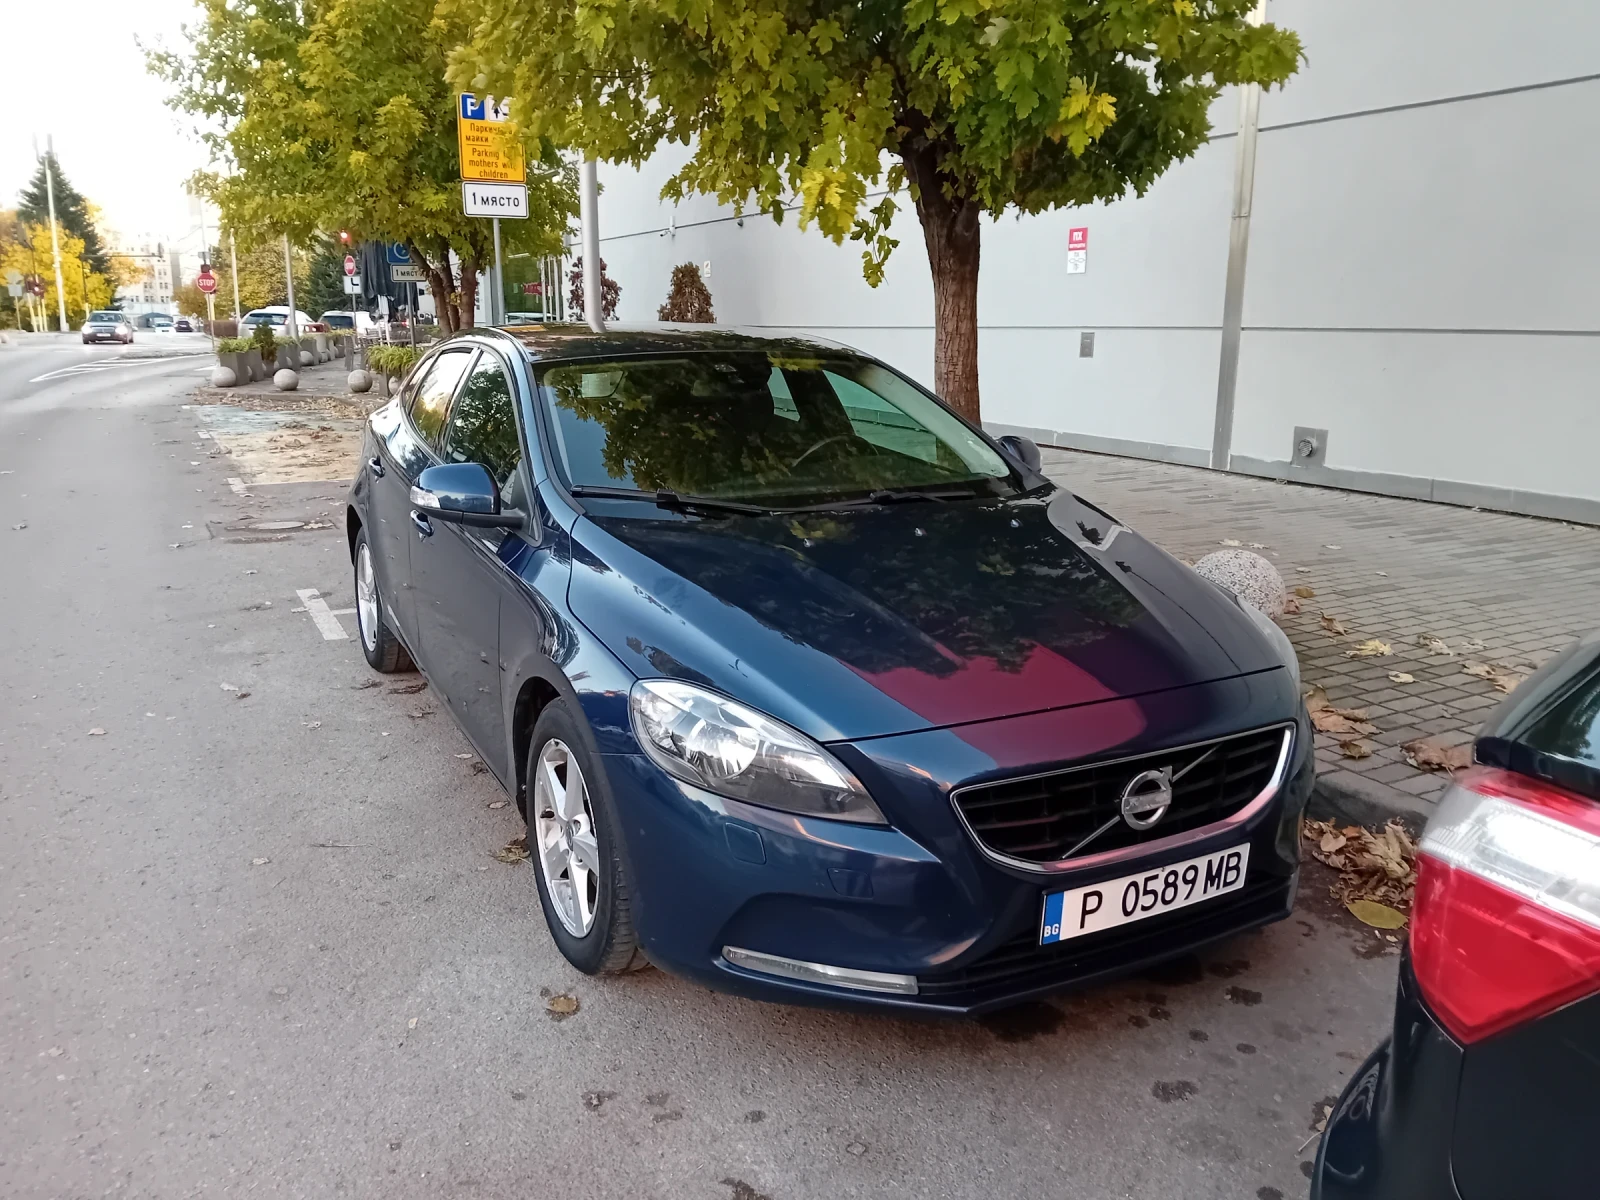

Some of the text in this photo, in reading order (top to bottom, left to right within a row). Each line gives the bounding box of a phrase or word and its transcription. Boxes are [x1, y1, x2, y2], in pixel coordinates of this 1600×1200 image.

[465, 134, 489, 143] майки
[468, 159, 499, 169] mothers
[479, 171, 509, 179] children
[472, 192, 477, 205] 1
[1121, 864, 1199, 917] 0589
[1043, 923, 1060, 938] BG
